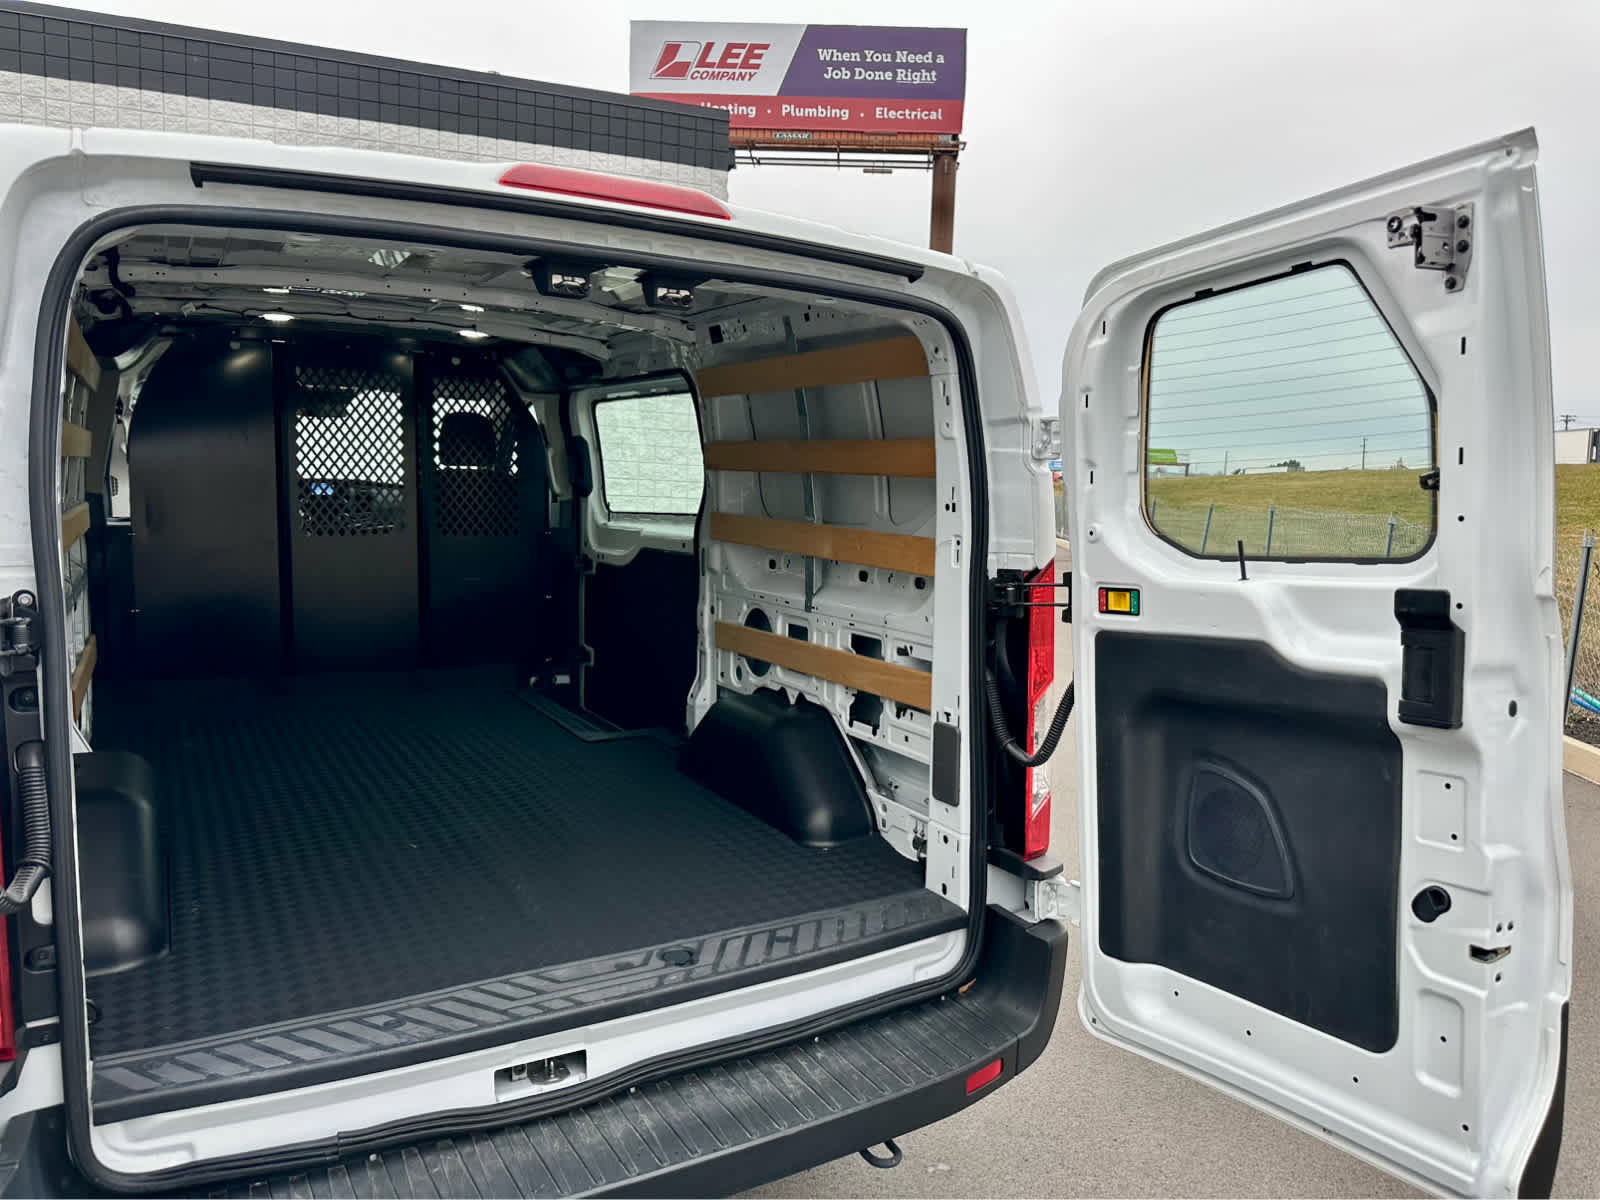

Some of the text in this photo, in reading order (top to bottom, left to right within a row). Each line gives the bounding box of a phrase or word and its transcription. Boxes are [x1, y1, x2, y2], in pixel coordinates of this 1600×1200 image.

[694, 41, 771, 70] LEE
[817, 48, 945, 63] When You Need a
[690, 70, 757, 82] COMPANY
[823, 67, 937, 84] Job Done Right
[781, 103, 849, 120] Plumbing
[875, 107, 943, 120] Electrical
